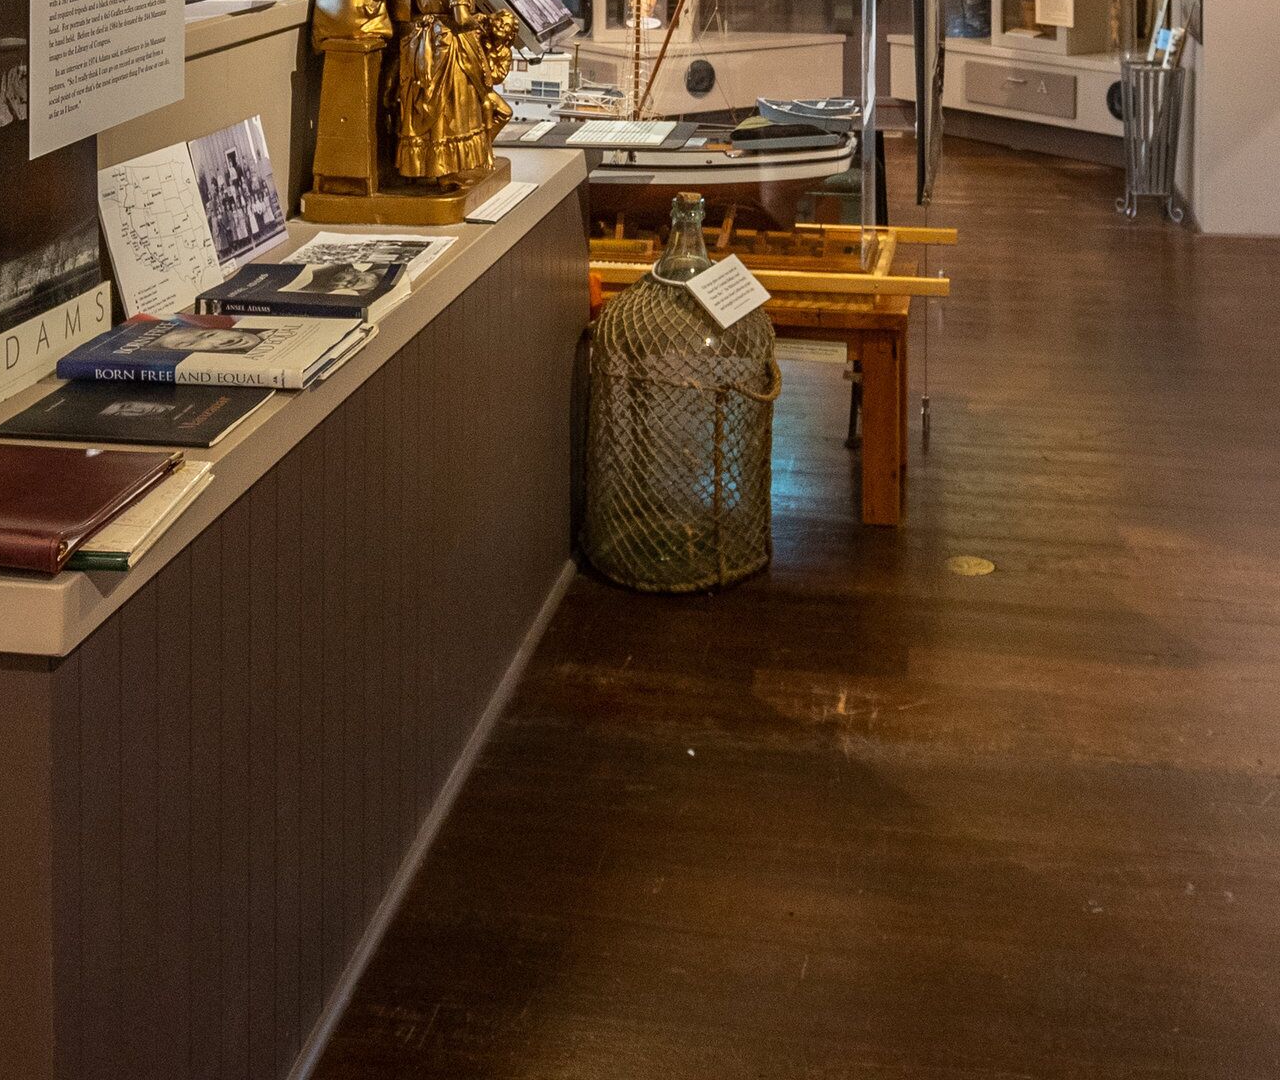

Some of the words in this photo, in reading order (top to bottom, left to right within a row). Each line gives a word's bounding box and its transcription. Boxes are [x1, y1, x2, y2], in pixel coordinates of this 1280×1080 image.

[225, 303, 246, 312] ANSEL
[247, 304, 271, 312] ADAMS
[95, 368, 135, 380] BORN
[141, 369, 173, 382] FREE
[178, 371, 211, 383] AND
[217, 372, 264, 385] EQUAL
